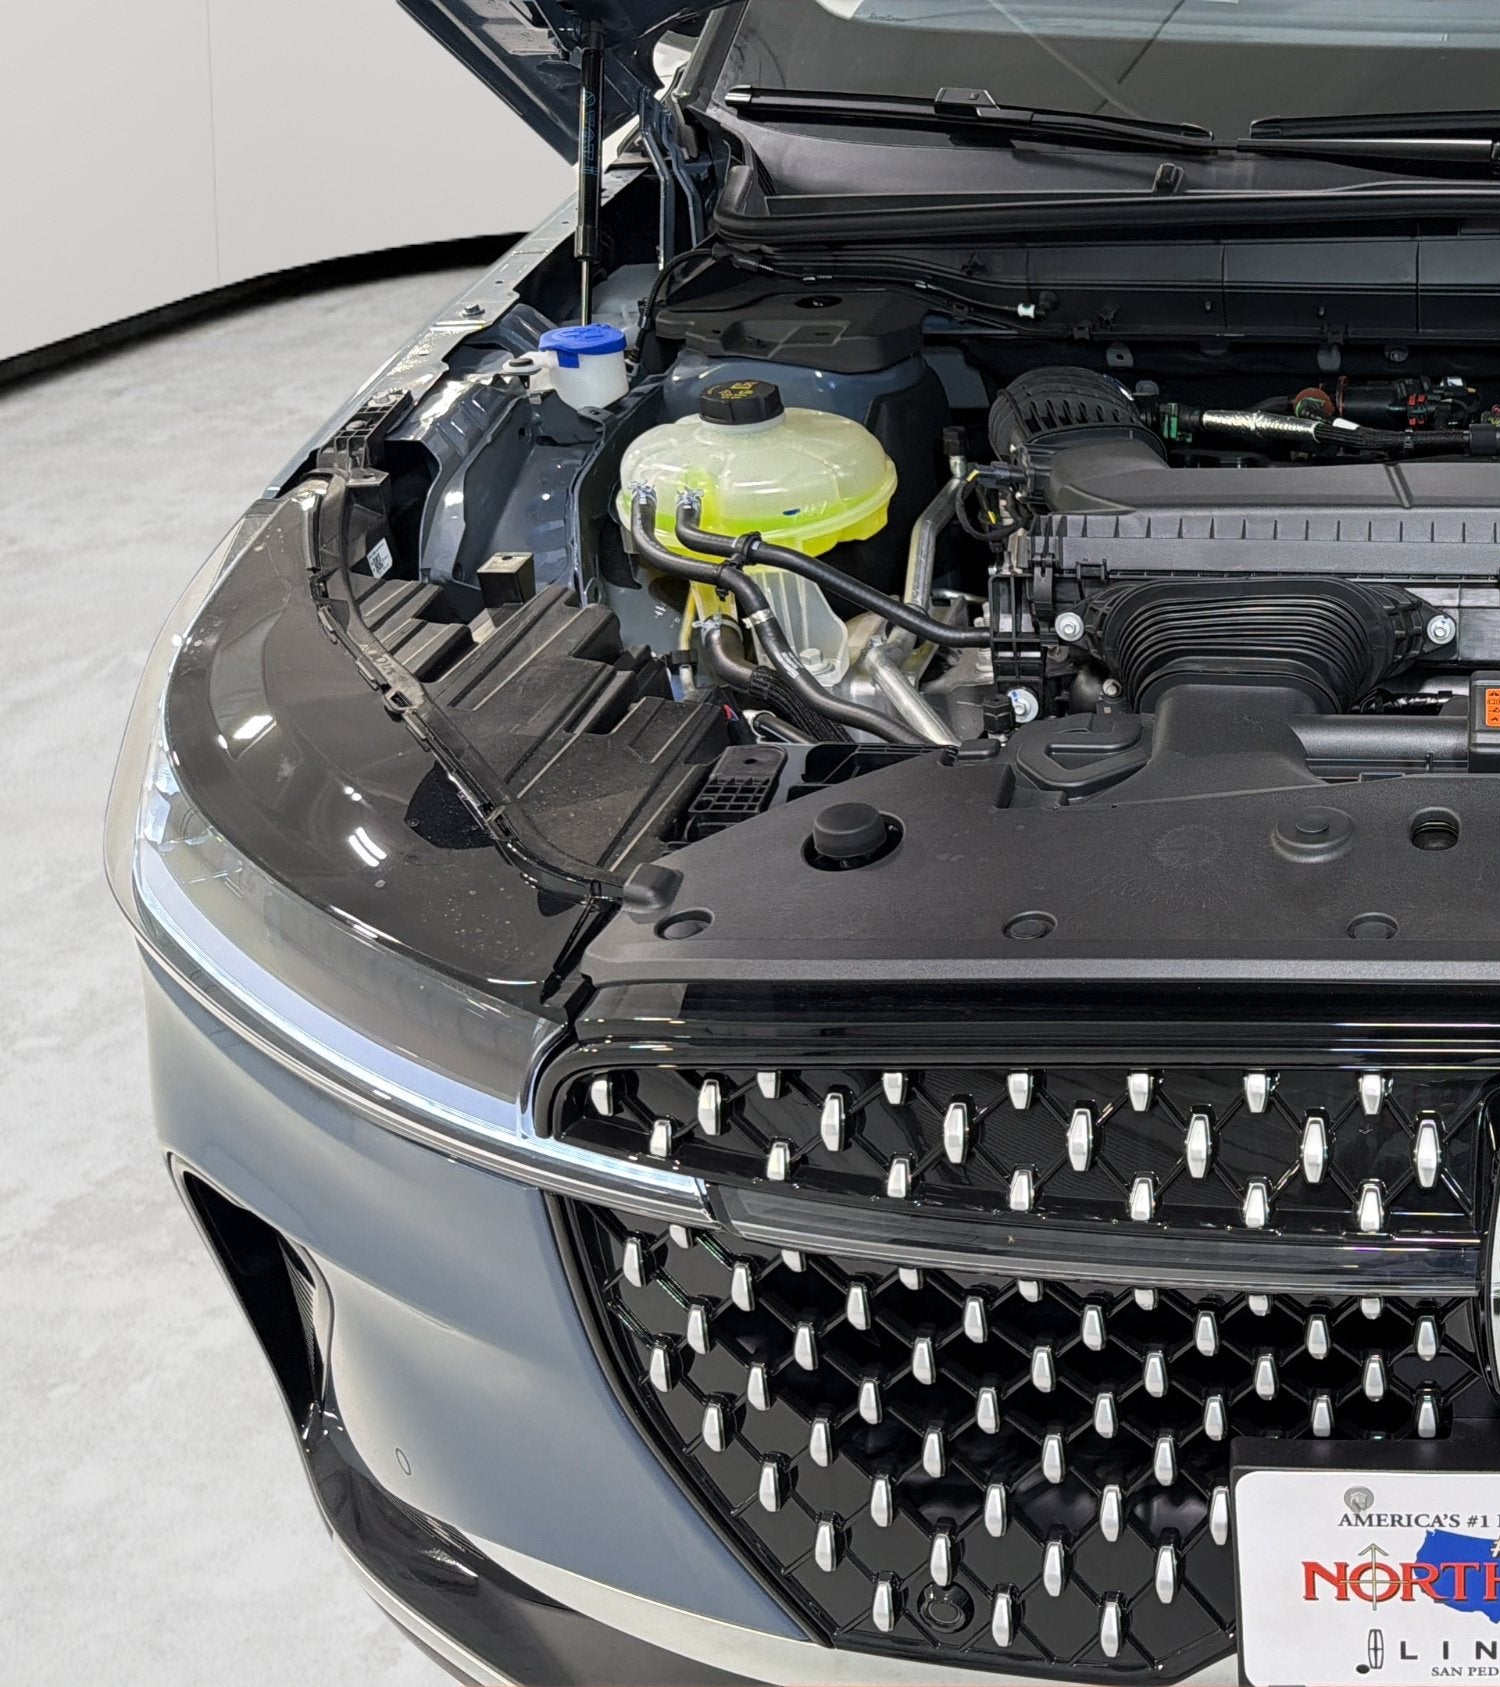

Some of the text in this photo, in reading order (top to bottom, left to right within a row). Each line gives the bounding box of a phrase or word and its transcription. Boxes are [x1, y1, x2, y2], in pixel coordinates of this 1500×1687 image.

[1337, 1513, 1461, 1528] AMERICA'S
[1467, 1514, 1490, 1528] #1
[1431, 1666, 1465, 1677] SAN
